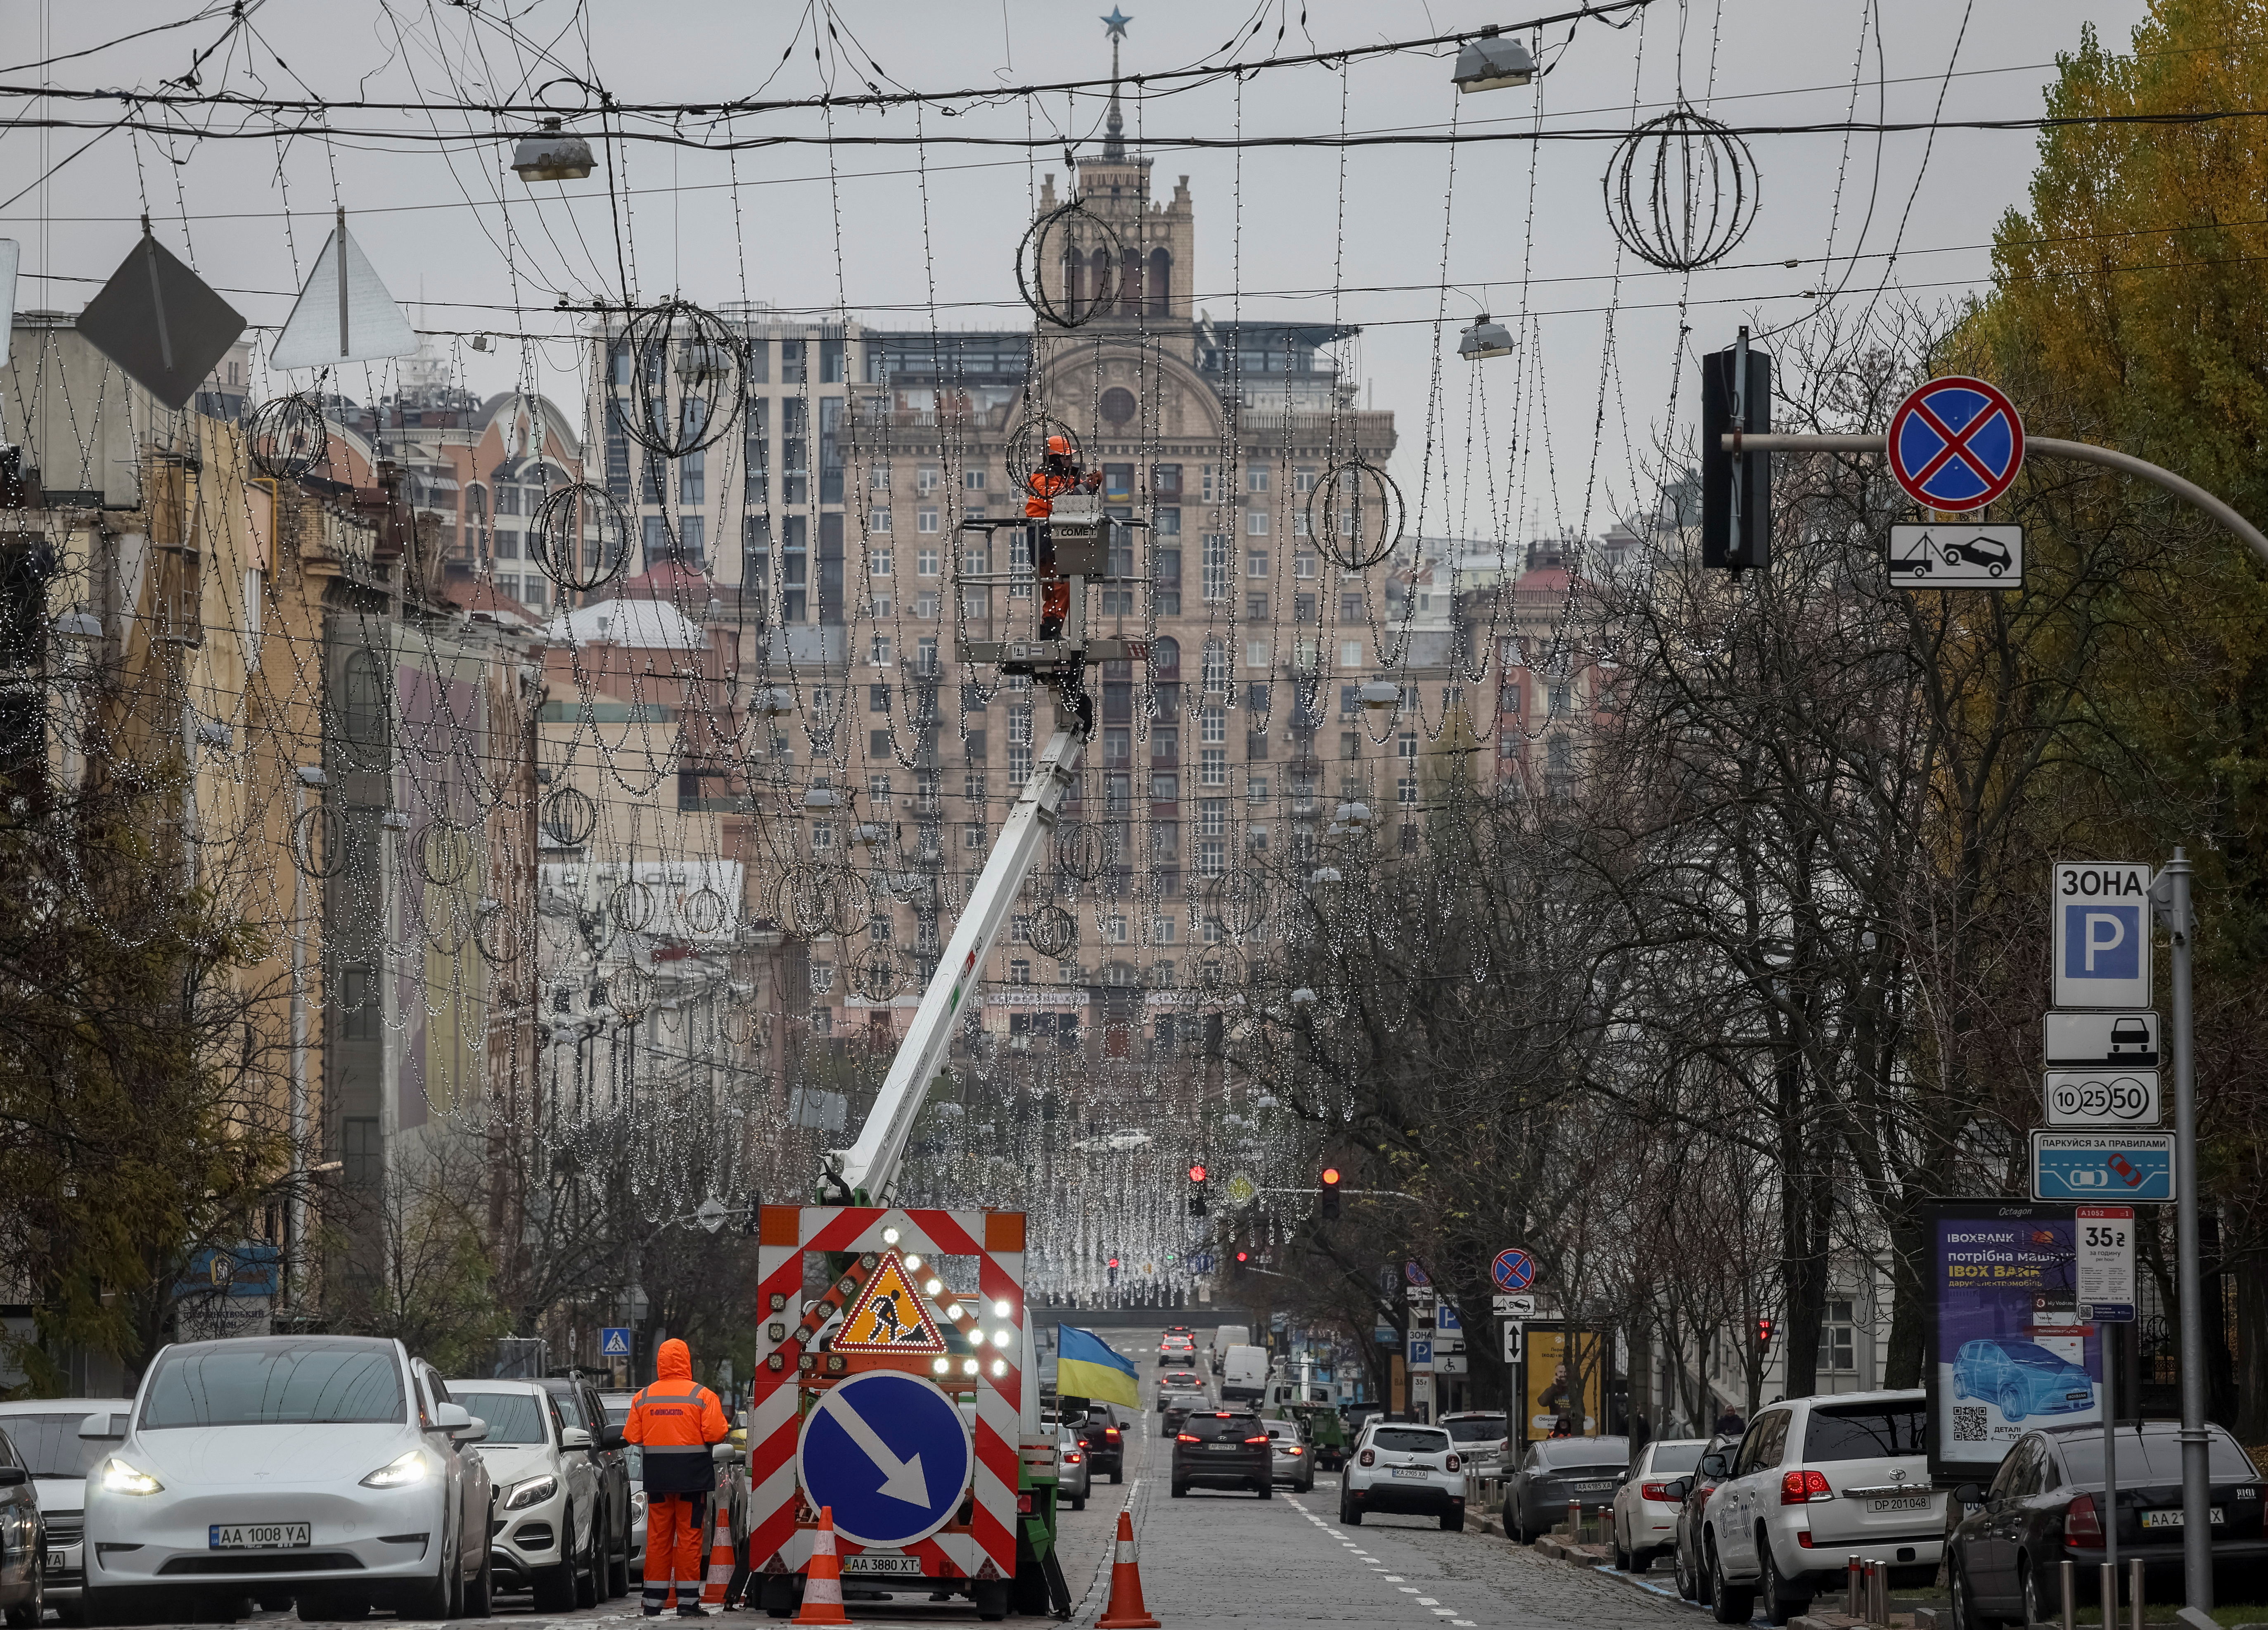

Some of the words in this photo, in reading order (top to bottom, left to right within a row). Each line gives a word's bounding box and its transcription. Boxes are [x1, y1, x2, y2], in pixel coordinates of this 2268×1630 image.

[2062, 870, 2144, 896] ЗОНА
[886, 1052, 929, 1142] www.officinecomet.com
[2057, 1092, 2075, 1107] 10
[2083, 1090, 2106, 1107] 25
[2113, 1088, 2142, 1109] 50
[2042, 1138, 2091, 1147] ПАРКУЙСЯ
[1999, 1207, 2033, 1217] Octagon
[1947, 1234, 2015, 1243] IBOXBANK
[1948, 1250, 2013, 1263] потрібна
[1949, 1266, 1989, 1277] IBOX
[1994, 1266, 2042, 1277] BANK
[1875, 1500, 1889, 1510] DP
[1891, 1499, 1908, 1509] 201
[1910, 1498, 1926, 1508] 048
[2152, 1513, 2169, 1526] AA
[220, 1529, 243, 1543] AA
[248, 1527, 281, 1542] 1008
[286, 1526, 306, 1541] YA
[852, 1559, 868, 1570] AA
[871, 1559, 897, 1571] 3880
[901, 1559, 917, 1571] XT
